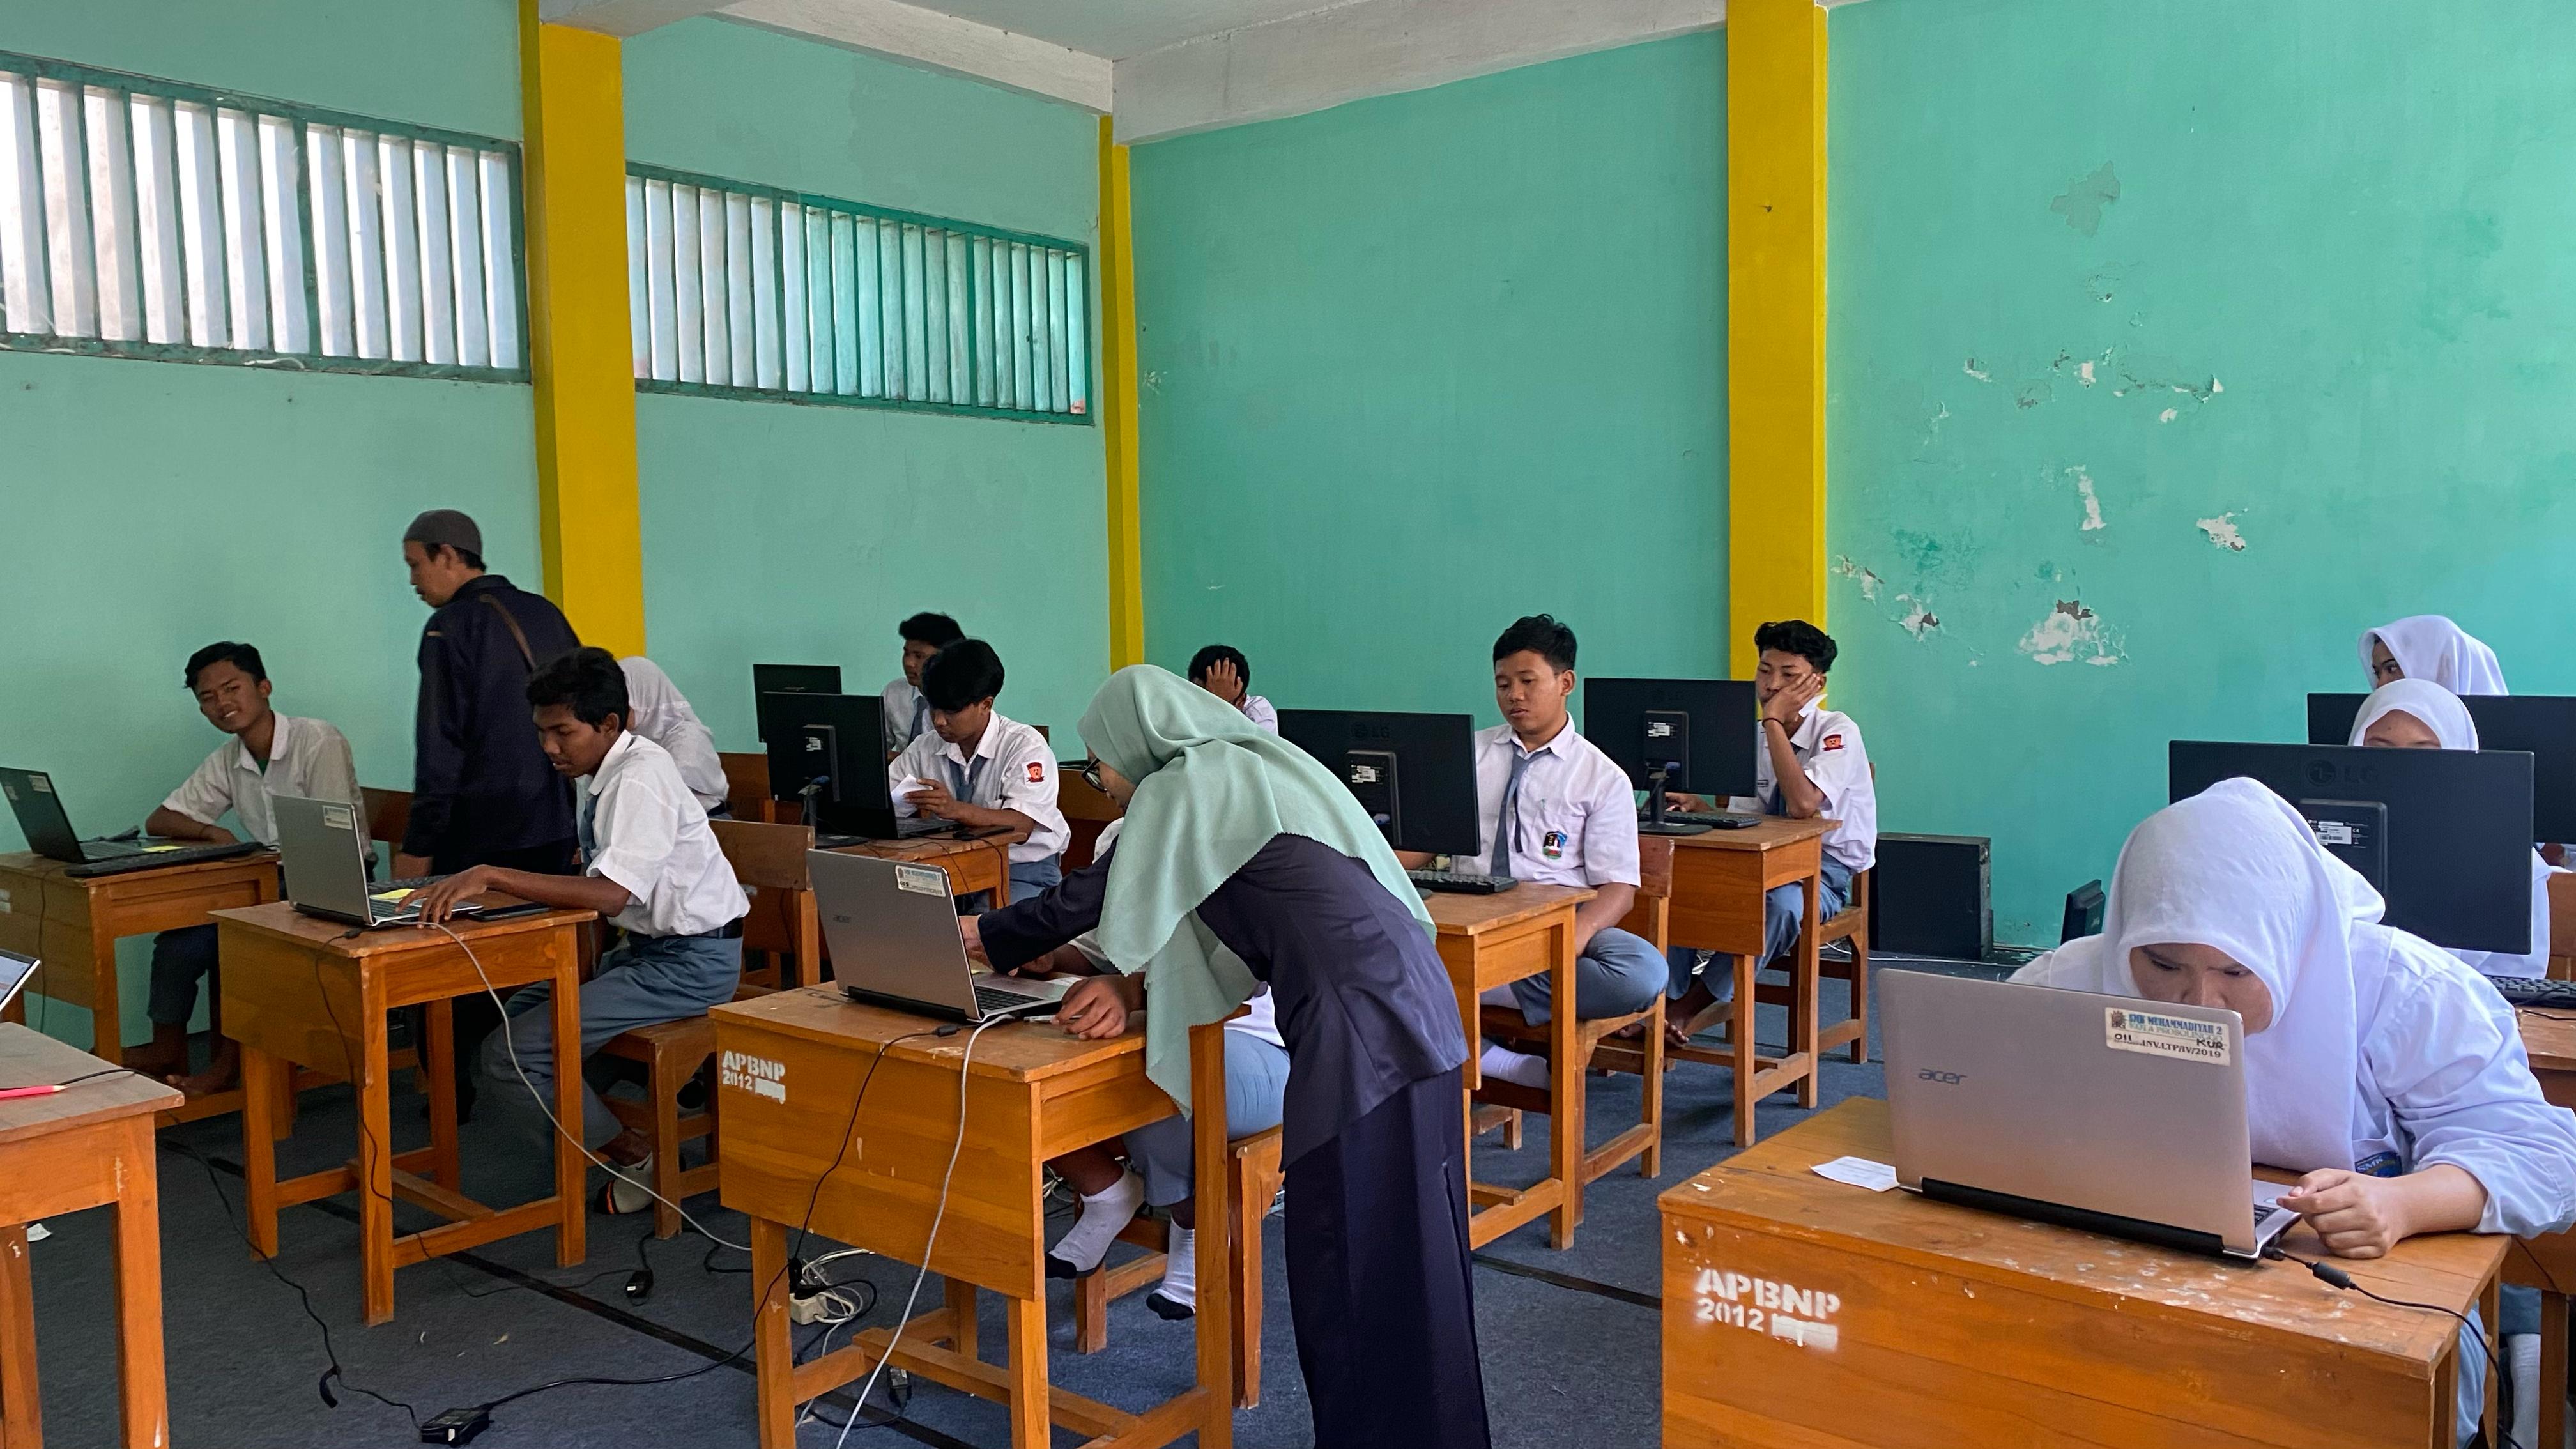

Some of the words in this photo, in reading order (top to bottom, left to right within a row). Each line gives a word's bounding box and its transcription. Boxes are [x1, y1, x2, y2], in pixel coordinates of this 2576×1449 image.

[832, 914, 852, 924] acer
[2147, 1016, 2214, 1034] MUHAMMADIYAH
[2216, 1025, 2223, 1035] 2
[2196, 1038, 2225, 1051] KUR
[722, 1050, 786, 1082] APBNP
[722, 1069, 753, 1091] 2012
[1918, 1068, 1967, 1085] acer
[1695, 1268, 1841, 1321] APBNP
[1695, 1297, 1765, 1333] 2012
